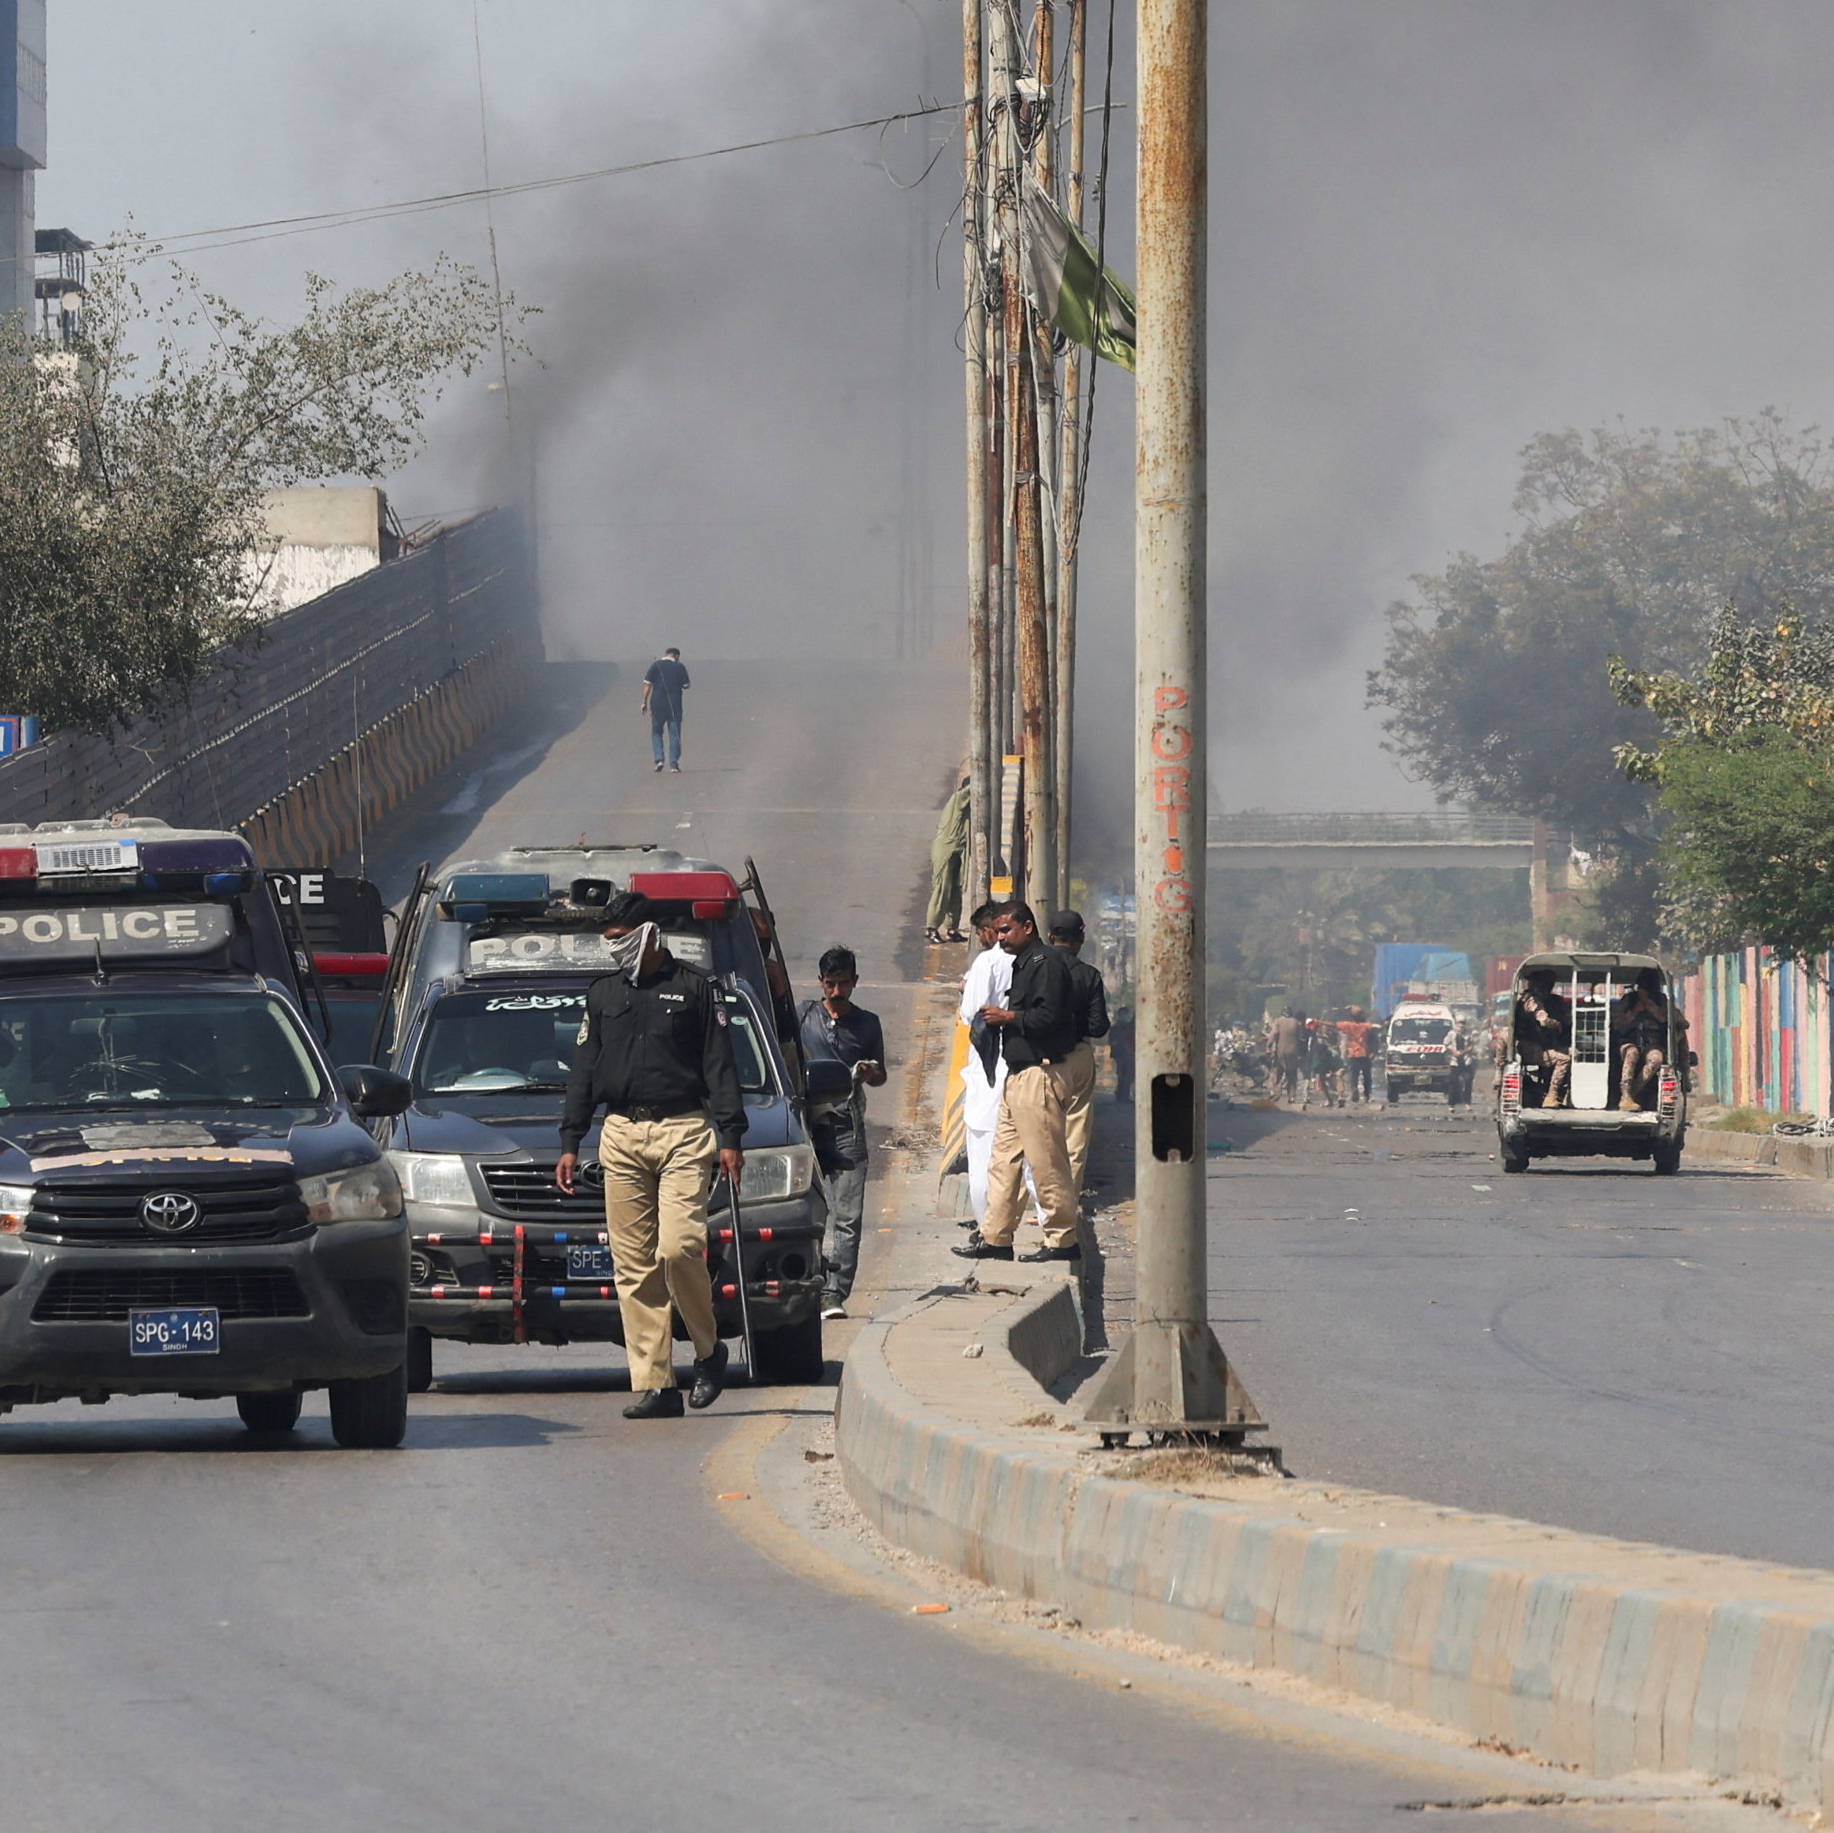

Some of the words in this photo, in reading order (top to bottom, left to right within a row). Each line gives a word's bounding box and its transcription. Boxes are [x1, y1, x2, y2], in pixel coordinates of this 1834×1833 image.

[469, 932, 704, 965] POLE
[658, 993, 685, 1002] POLICE
[162, 1343, 188, 1351] SINDH
